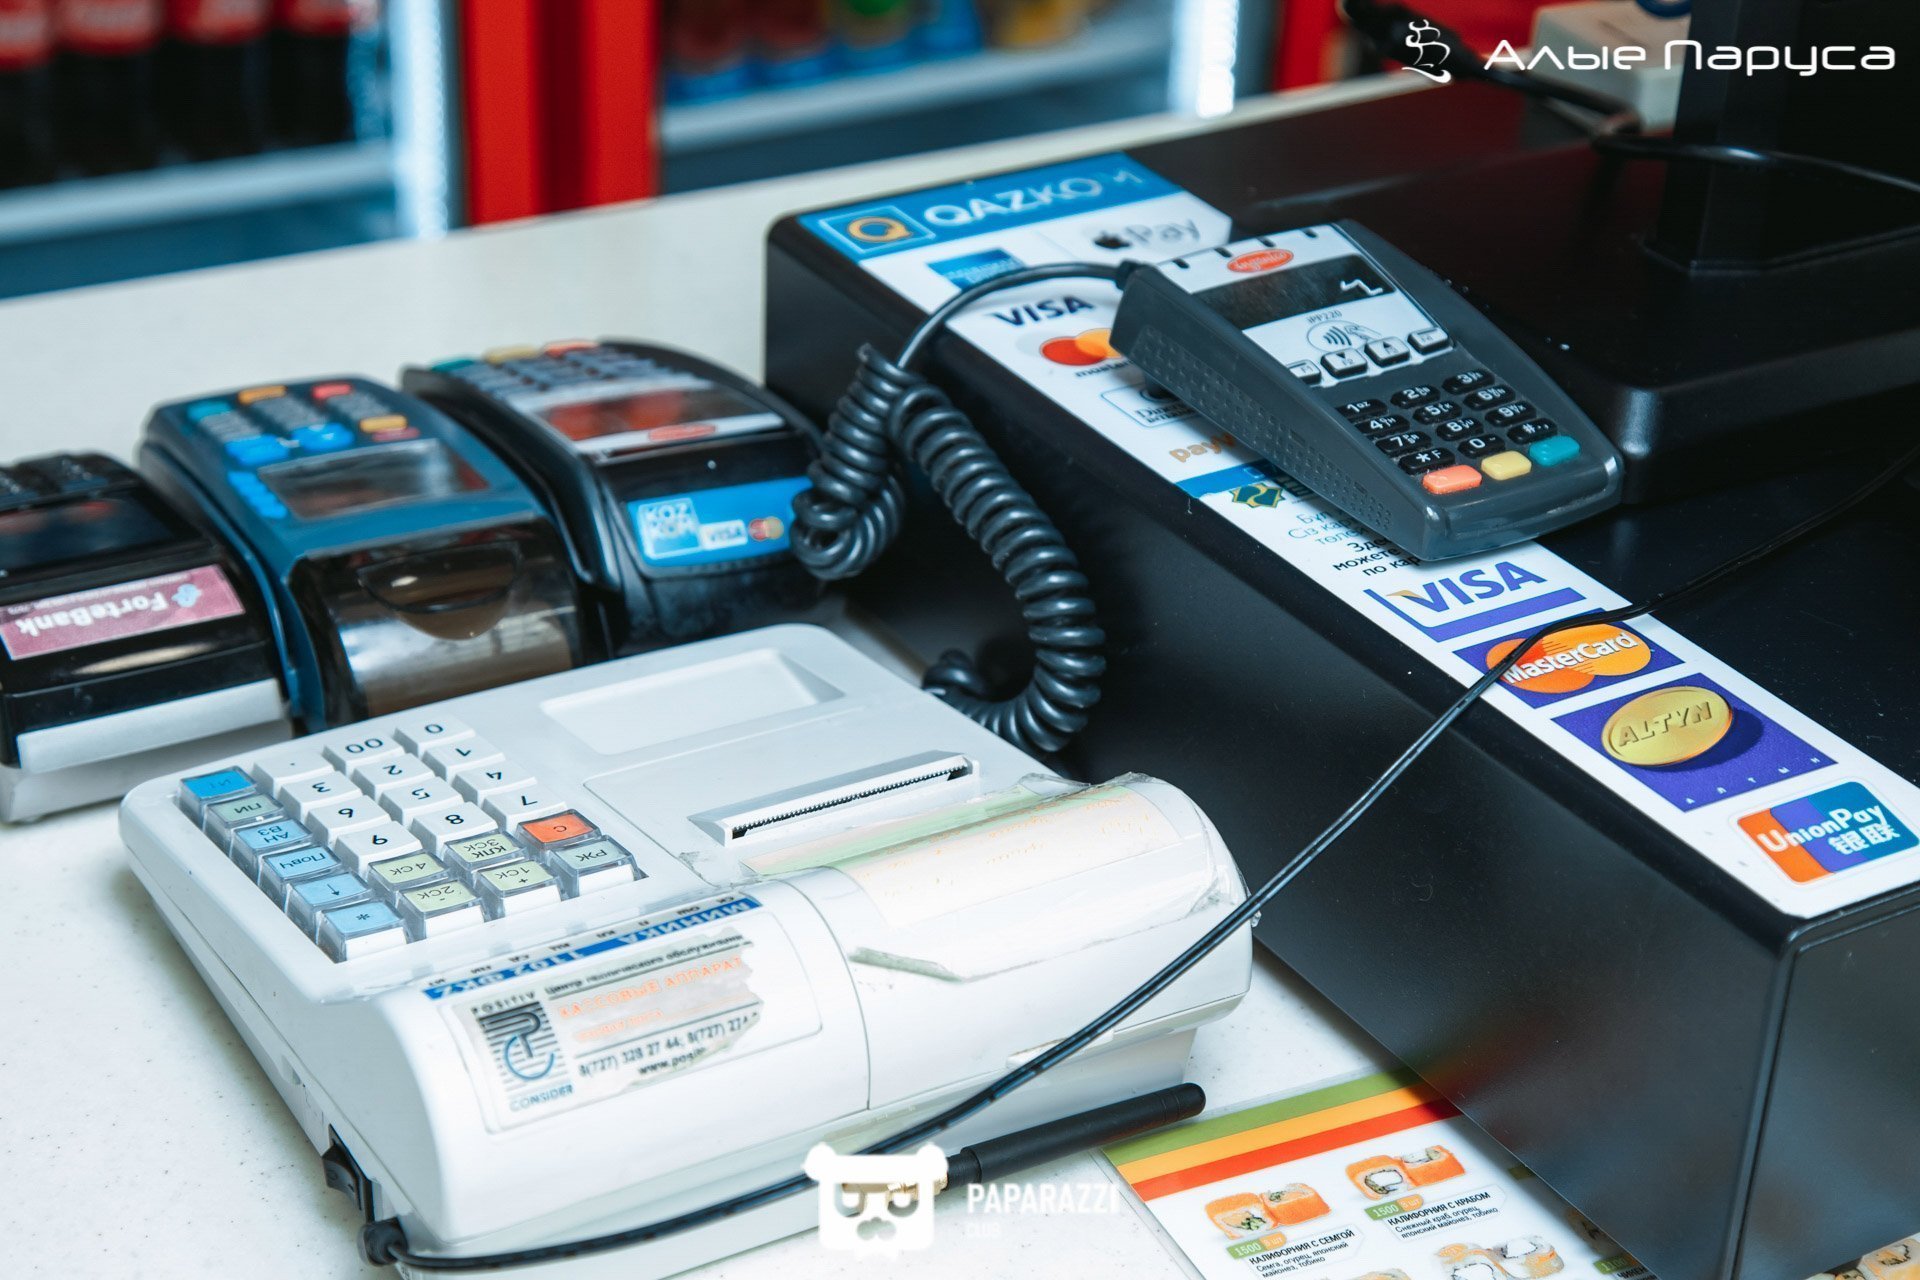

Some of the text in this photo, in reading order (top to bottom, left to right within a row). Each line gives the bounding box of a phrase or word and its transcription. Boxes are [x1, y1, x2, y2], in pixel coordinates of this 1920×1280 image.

[1125, 219, 1201, 246] Pay
[990, 295, 1095, 327] VISA
[1307, 310, 1343, 324] iPP220
[1363, 565, 1388, 577] по
[1388, 561, 1548, 613] VISA
[16, 591, 166, 637] ForteBank
[1501, 630, 1638, 685] MasterCard
[425, 723, 444, 734] 0
[1617, 701, 1713, 747] ALTYN
[346, 738, 384, 754] 00
[455, 746, 472, 757] 1
[383, 764, 403, 776] 2
[486, 771, 503, 781] 4
[312, 781, 331, 793] 3
[411, 788, 431, 800] 5
[521, 795, 538, 806] 7
[234, 803, 262, 815] ПИ
[338, 807, 354, 819] 6
[445, 814, 465, 826] 8
[1756, 802, 1886, 854] UnionPay
[263, 831, 289, 844] АН
[371, 834, 388, 845] 9
[1827, 822, 1900, 856] 银联
[576, 848, 607, 863] РЖ
[618, 899, 751, 945] МИНИКА
[470, 991, 535, 1015] POSITIV
[509, 1084, 574, 1113] CONSIDER
[1372, 1203, 1399, 1218] 1500
[1388, 1203, 1448, 1226] КАЛИФОРНИЯ
[1455, 1191, 1491, 1207] КРАБОМ
[1235, 1242, 1262, 1257] 1500
[1249, 1242, 1312, 1265] КАЛИФОРНИЯ
[1318, 1228, 1356, 1246] СЕМГОЙ
